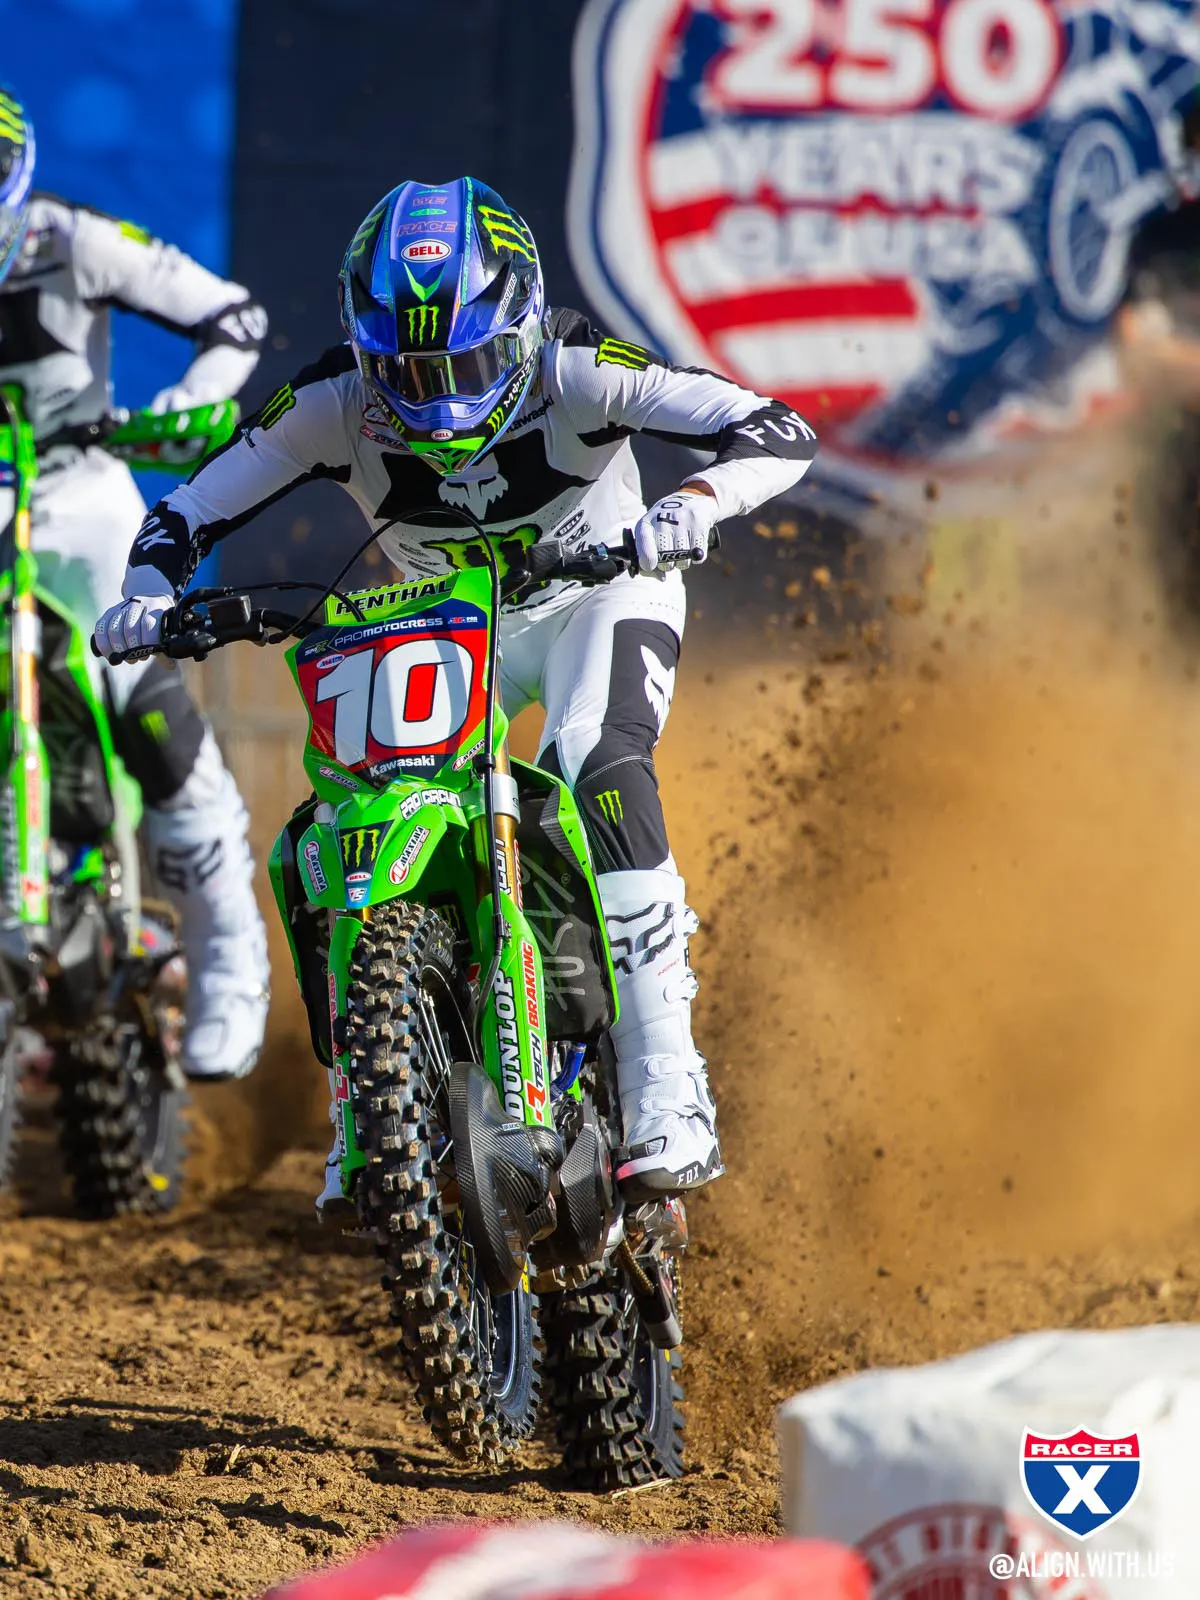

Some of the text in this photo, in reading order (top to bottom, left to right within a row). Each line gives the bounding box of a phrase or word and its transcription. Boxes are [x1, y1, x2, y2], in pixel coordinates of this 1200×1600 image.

[712, 0, 1052, 112] 250
[397, 221, 457, 237] RACE
[408, 245, 443, 257] BELL
[335, 579, 453, 617] RENTHAL
[315, 638, 474, 768] 10
[369, 755, 435, 777] Kawasaki
[400, 789, 461, 820] PRO CIRCUIT
[400, 826, 425, 867] MAXIMA
[520, 940, 540, 1030] BRAKING
[494, 968, 526, 1123] DUNLOP
[676, 1164, 699, 1188] FOX
